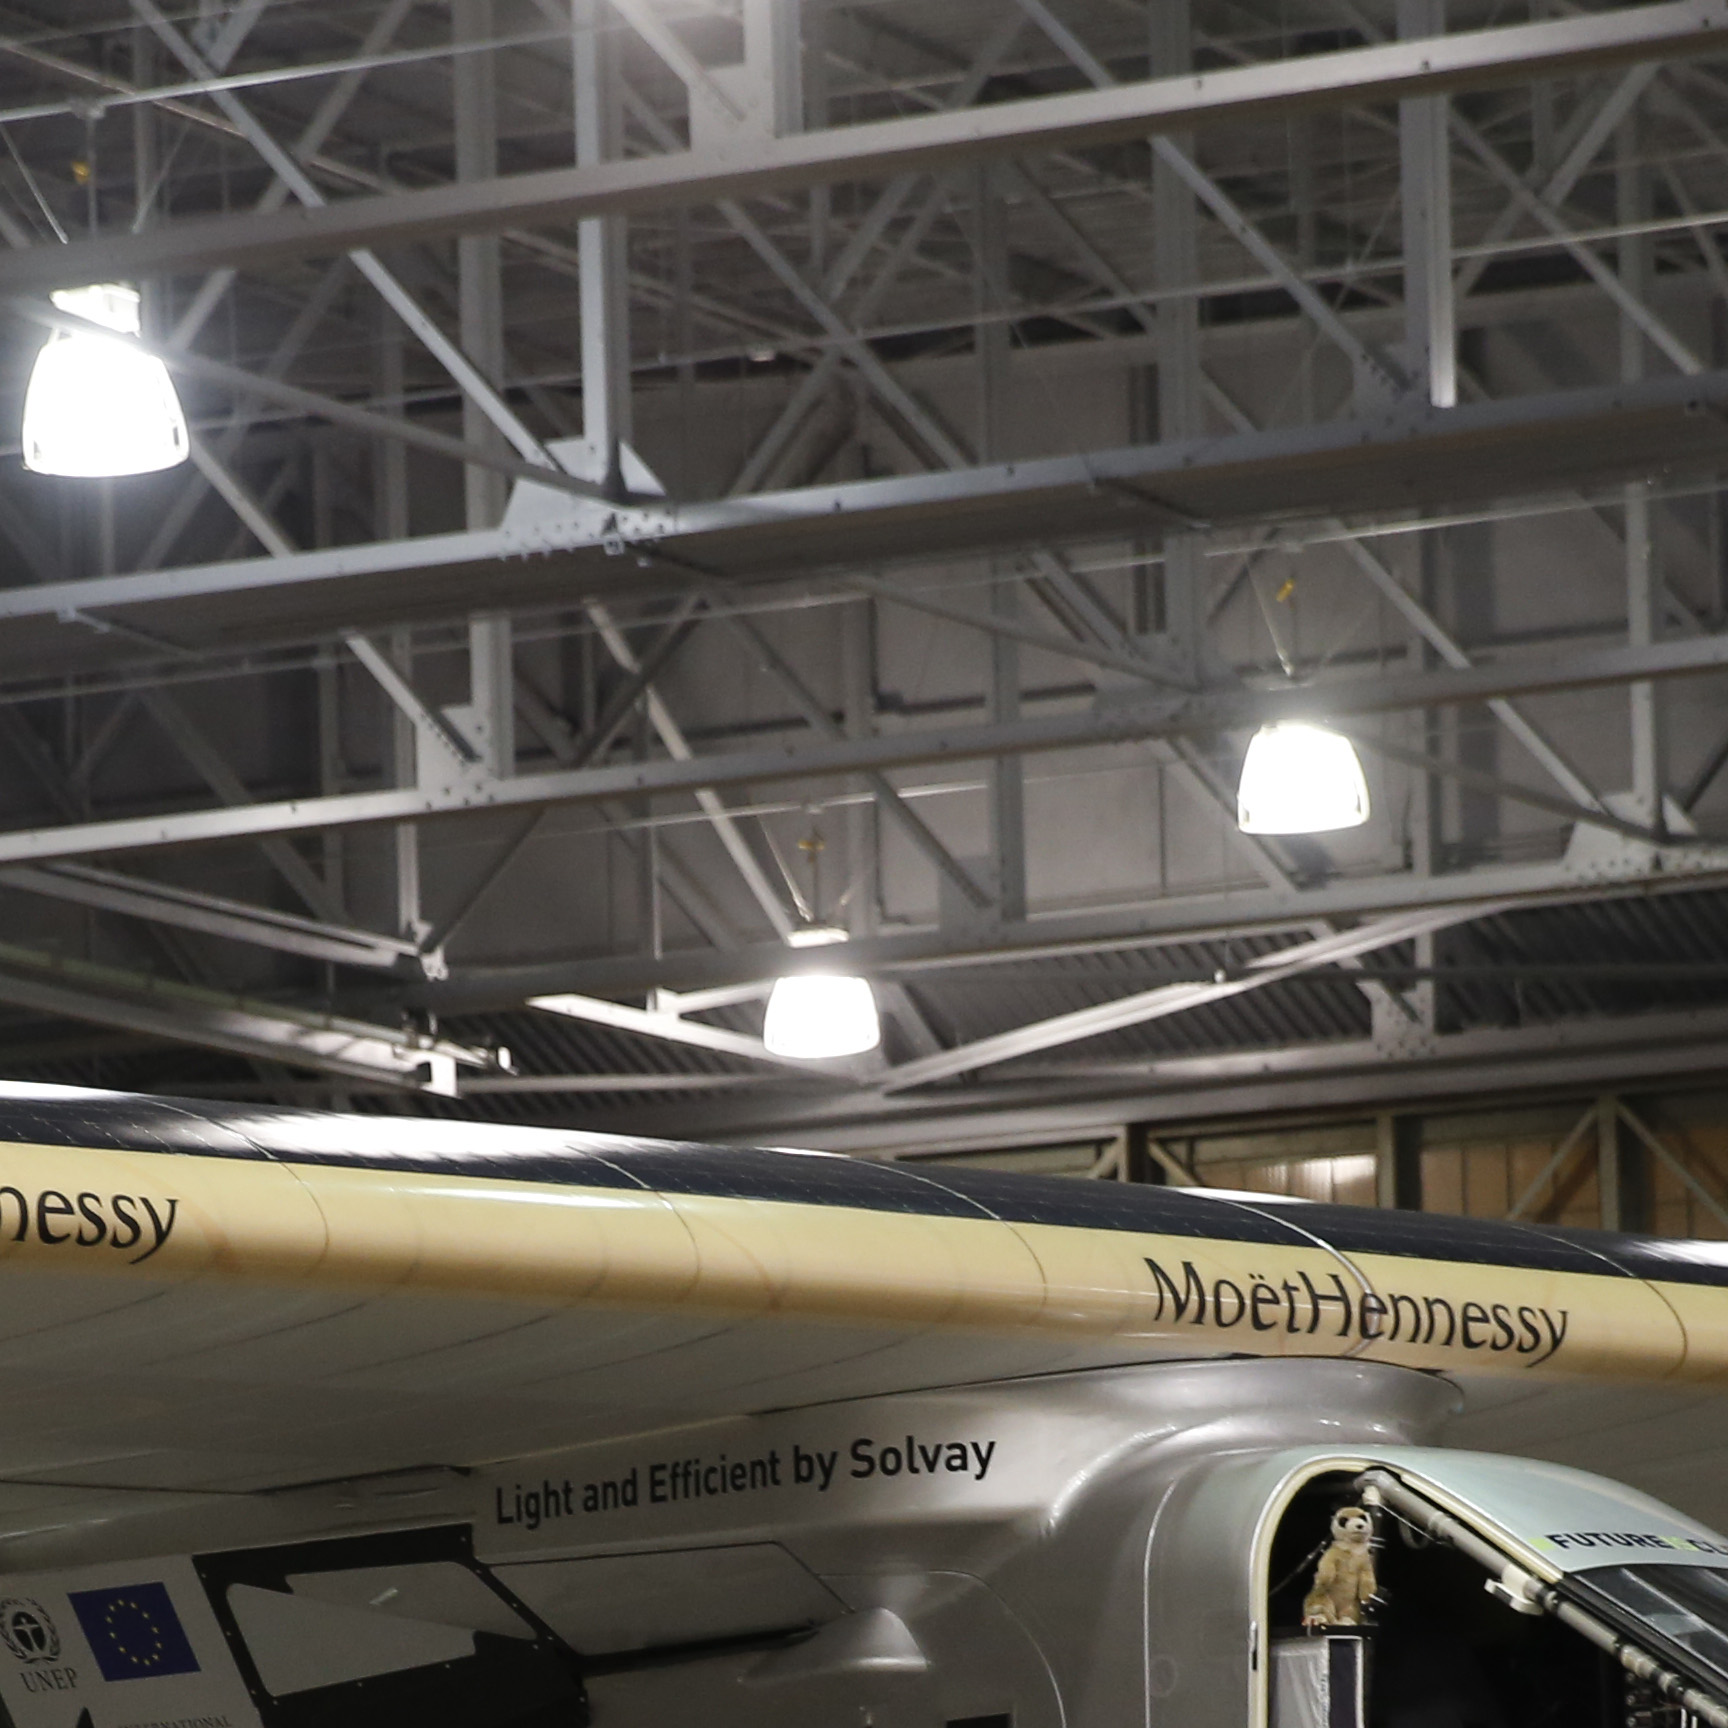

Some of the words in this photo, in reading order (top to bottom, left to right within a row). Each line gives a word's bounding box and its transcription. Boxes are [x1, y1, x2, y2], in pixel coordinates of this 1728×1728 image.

[1143, 1257, 1569, 1369] MoëtHennessy
[496, 1479, 573, 1530] Light
[582, 1467, 639, 1512] and
[649, 1450, 781, 1504] Efficient
[793, 1445, 837, 1491] by
[850, 1435, 998, 1481] Solvay
[19, 1668, 78, 1693] UNEP
